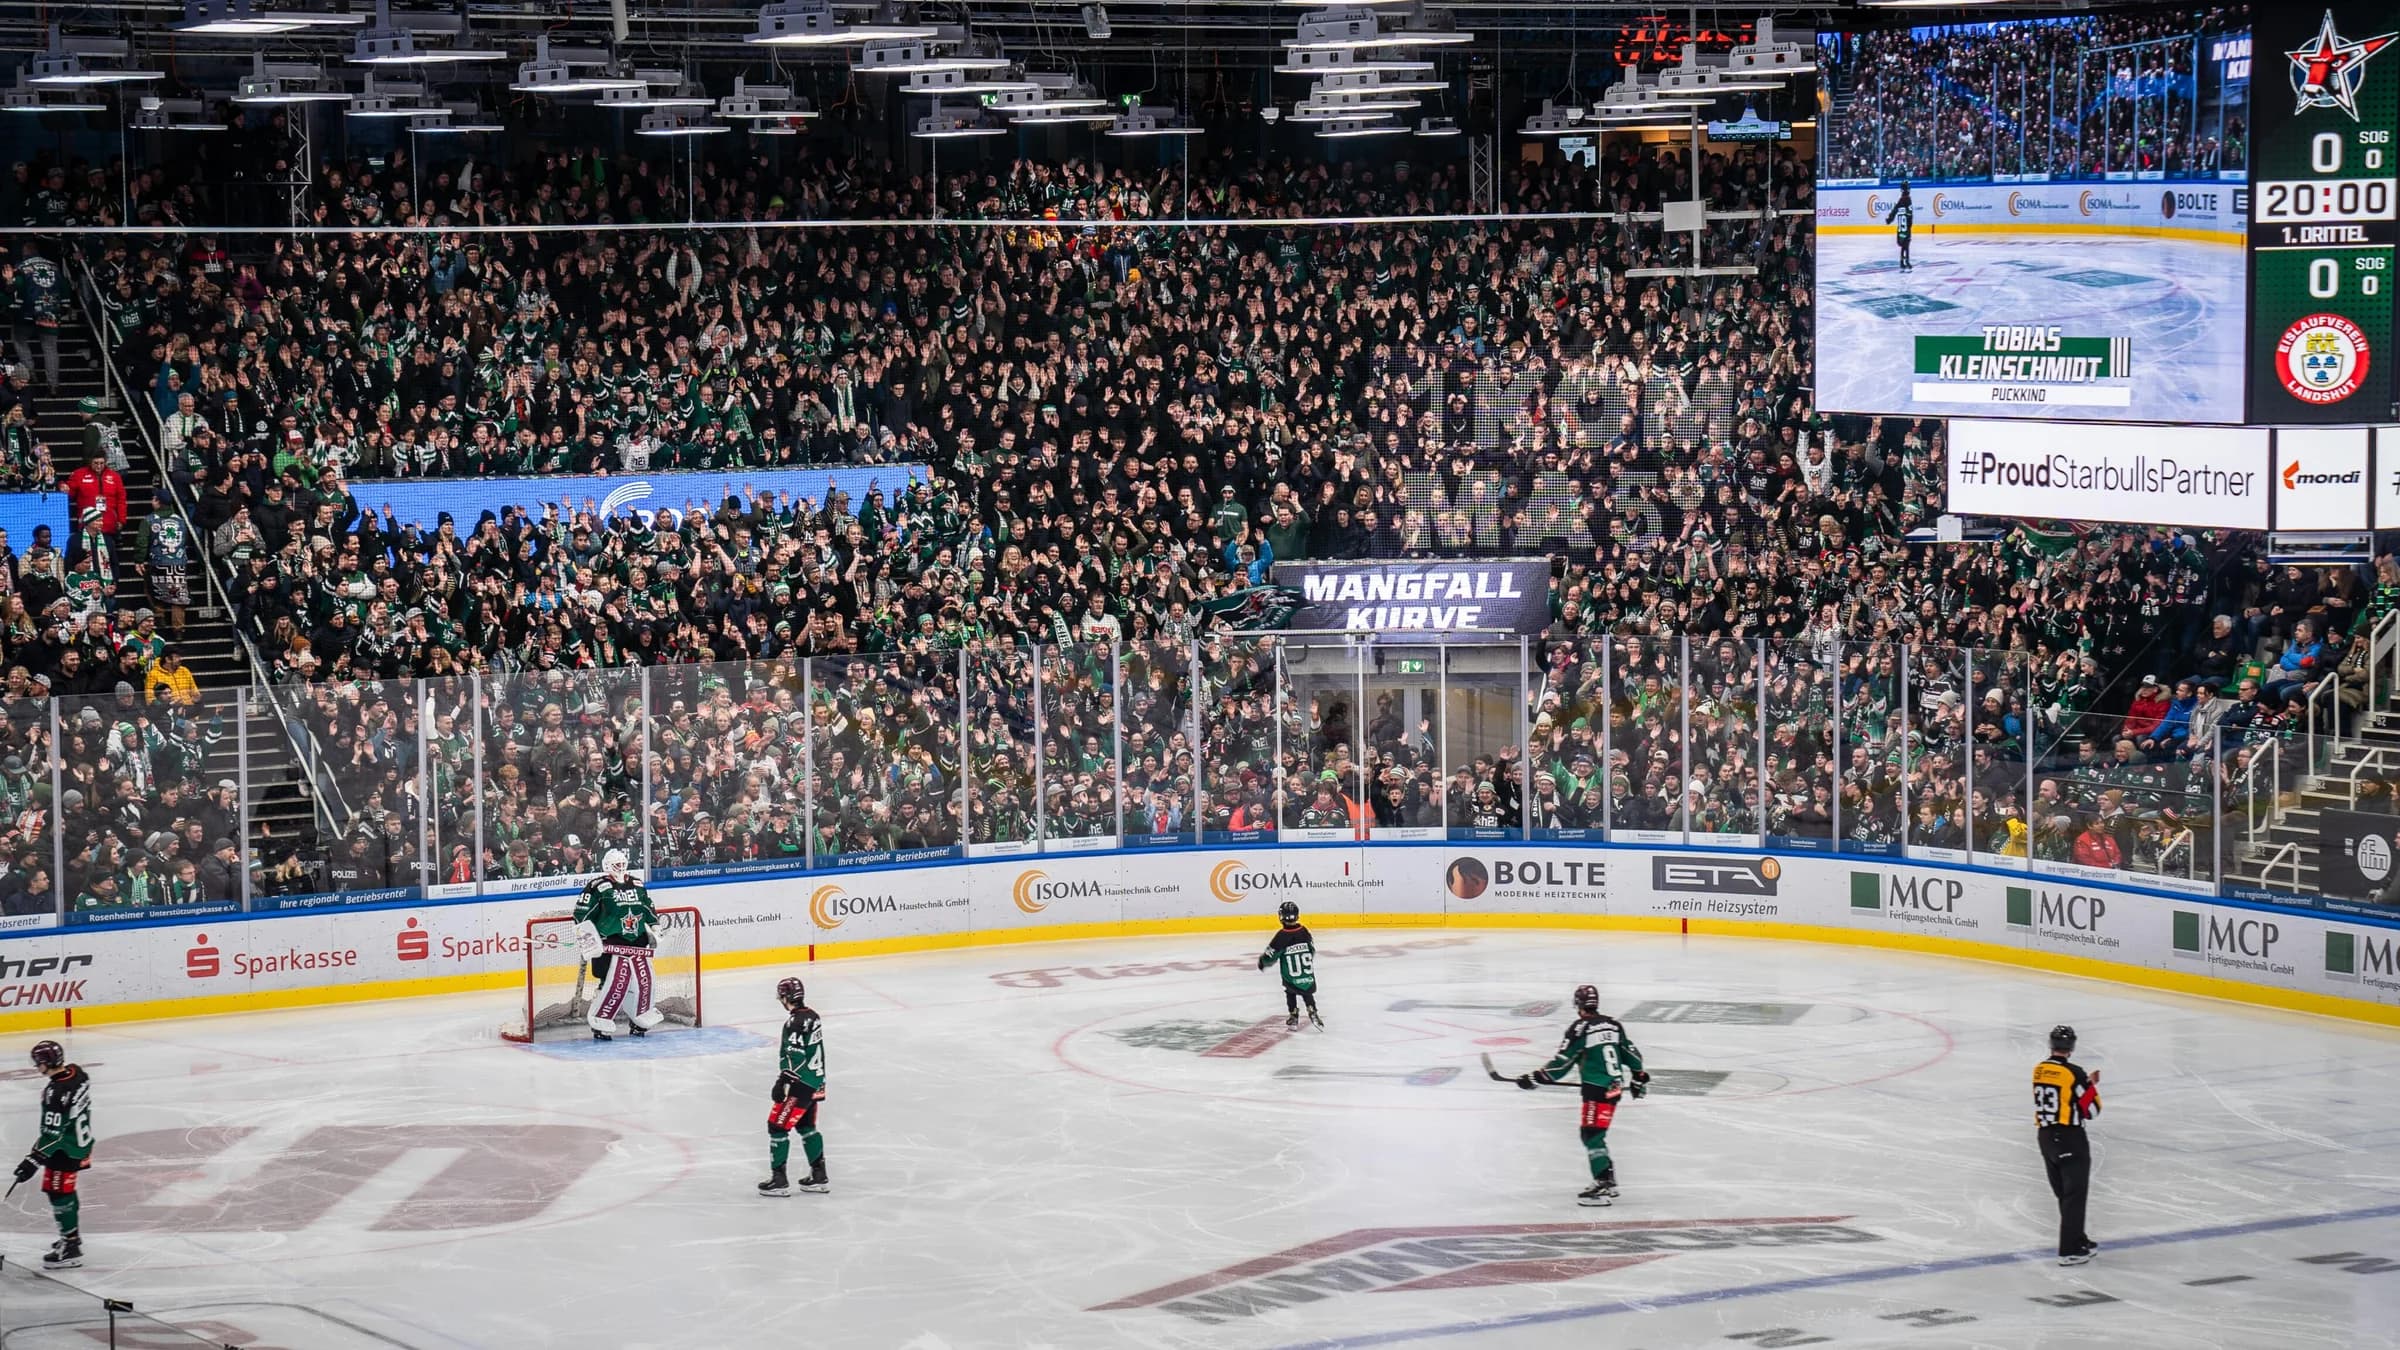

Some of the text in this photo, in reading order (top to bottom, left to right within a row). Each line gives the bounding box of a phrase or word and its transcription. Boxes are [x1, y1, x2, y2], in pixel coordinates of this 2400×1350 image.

[2359, 131, 2389, 144] SOG
[2312, 132, 2342, 173] 0
[2365, 149, 2382, 169] 0
[2177, 193, 2218, 211] BOLTE
[2267, 182, 2386, 216] 20:00
[2282, 225, 2369, 243] 1. DRITTEL
[2355, 257, 2386, 270] SOG
[2309, 258, 2339, 299] 0
[2362, 275, 2379, 295] 0
[1982, 325, 2062, 351] TOBIAS
[2278, 316, 2369, 354] EISLAUFVEREIN
[1938, 354, 2104, 383] KLEINSCHMIDT
[2287, 379, 2357, 401] LANDSHUT
[1960, 450, 2255, 497] #ProudStarbullsPartner
[2296, 470, 2362, 484] mondi
[1303, 571, 1522, 602] MANGFALL
[1346, 606, 1482, 630] KURVE
[838, 848, 950, 865] Ihre regionale Betriebsrente!
[672, 867, 721, 878] Rosenheimer
[1234, 872, 1384, 890] ISOMA Haustechnik GmbH
[1495, 861, 1606, 887] BOLTE
[1665, 863, 1766, 888] ETA
[511, 881, 527, 891] Ihre
[528, 878, 567, 890] regionale
[1036, 880, 1180, 900] ISOMA Haustechnik GmbH
[1495, 890, 1606, 899] MODERNE HEIZTECHNIK
[1889, 874, 1964, 913] MCP
[280, 890, 407, 909] Ihre regionale Betriebsrente!
[832, 895, 970, 916] ISOMA Haustechnik GmbH
[1707, 898, 1778, 916] Heizsystem
[89, 909, 145, 923] Rosenheimer
[149, 906, 222, 918] Unterstützungskasse
[708, 915, 755, 927] Haustechnik
[756, 913, 782, 923] GmbH
[1889, 911, 1979, 928] Fertigungstechnik GmbH
[2039, 890, 2106, 932] MCP
[2039, 928, 2120, 948] Fertigungstechnik GmbH
[2207, 915, 2279, 958] MCP
[233, 947, 358, 979] Sparkasse
[2207, 953, 2295, 976] Fertigungstechnik GmbH
[788, 1031, 805, 1047] 44
[2034, 1085, 2059, 1113] 33
[44, 1111, 62, 1126] 60
